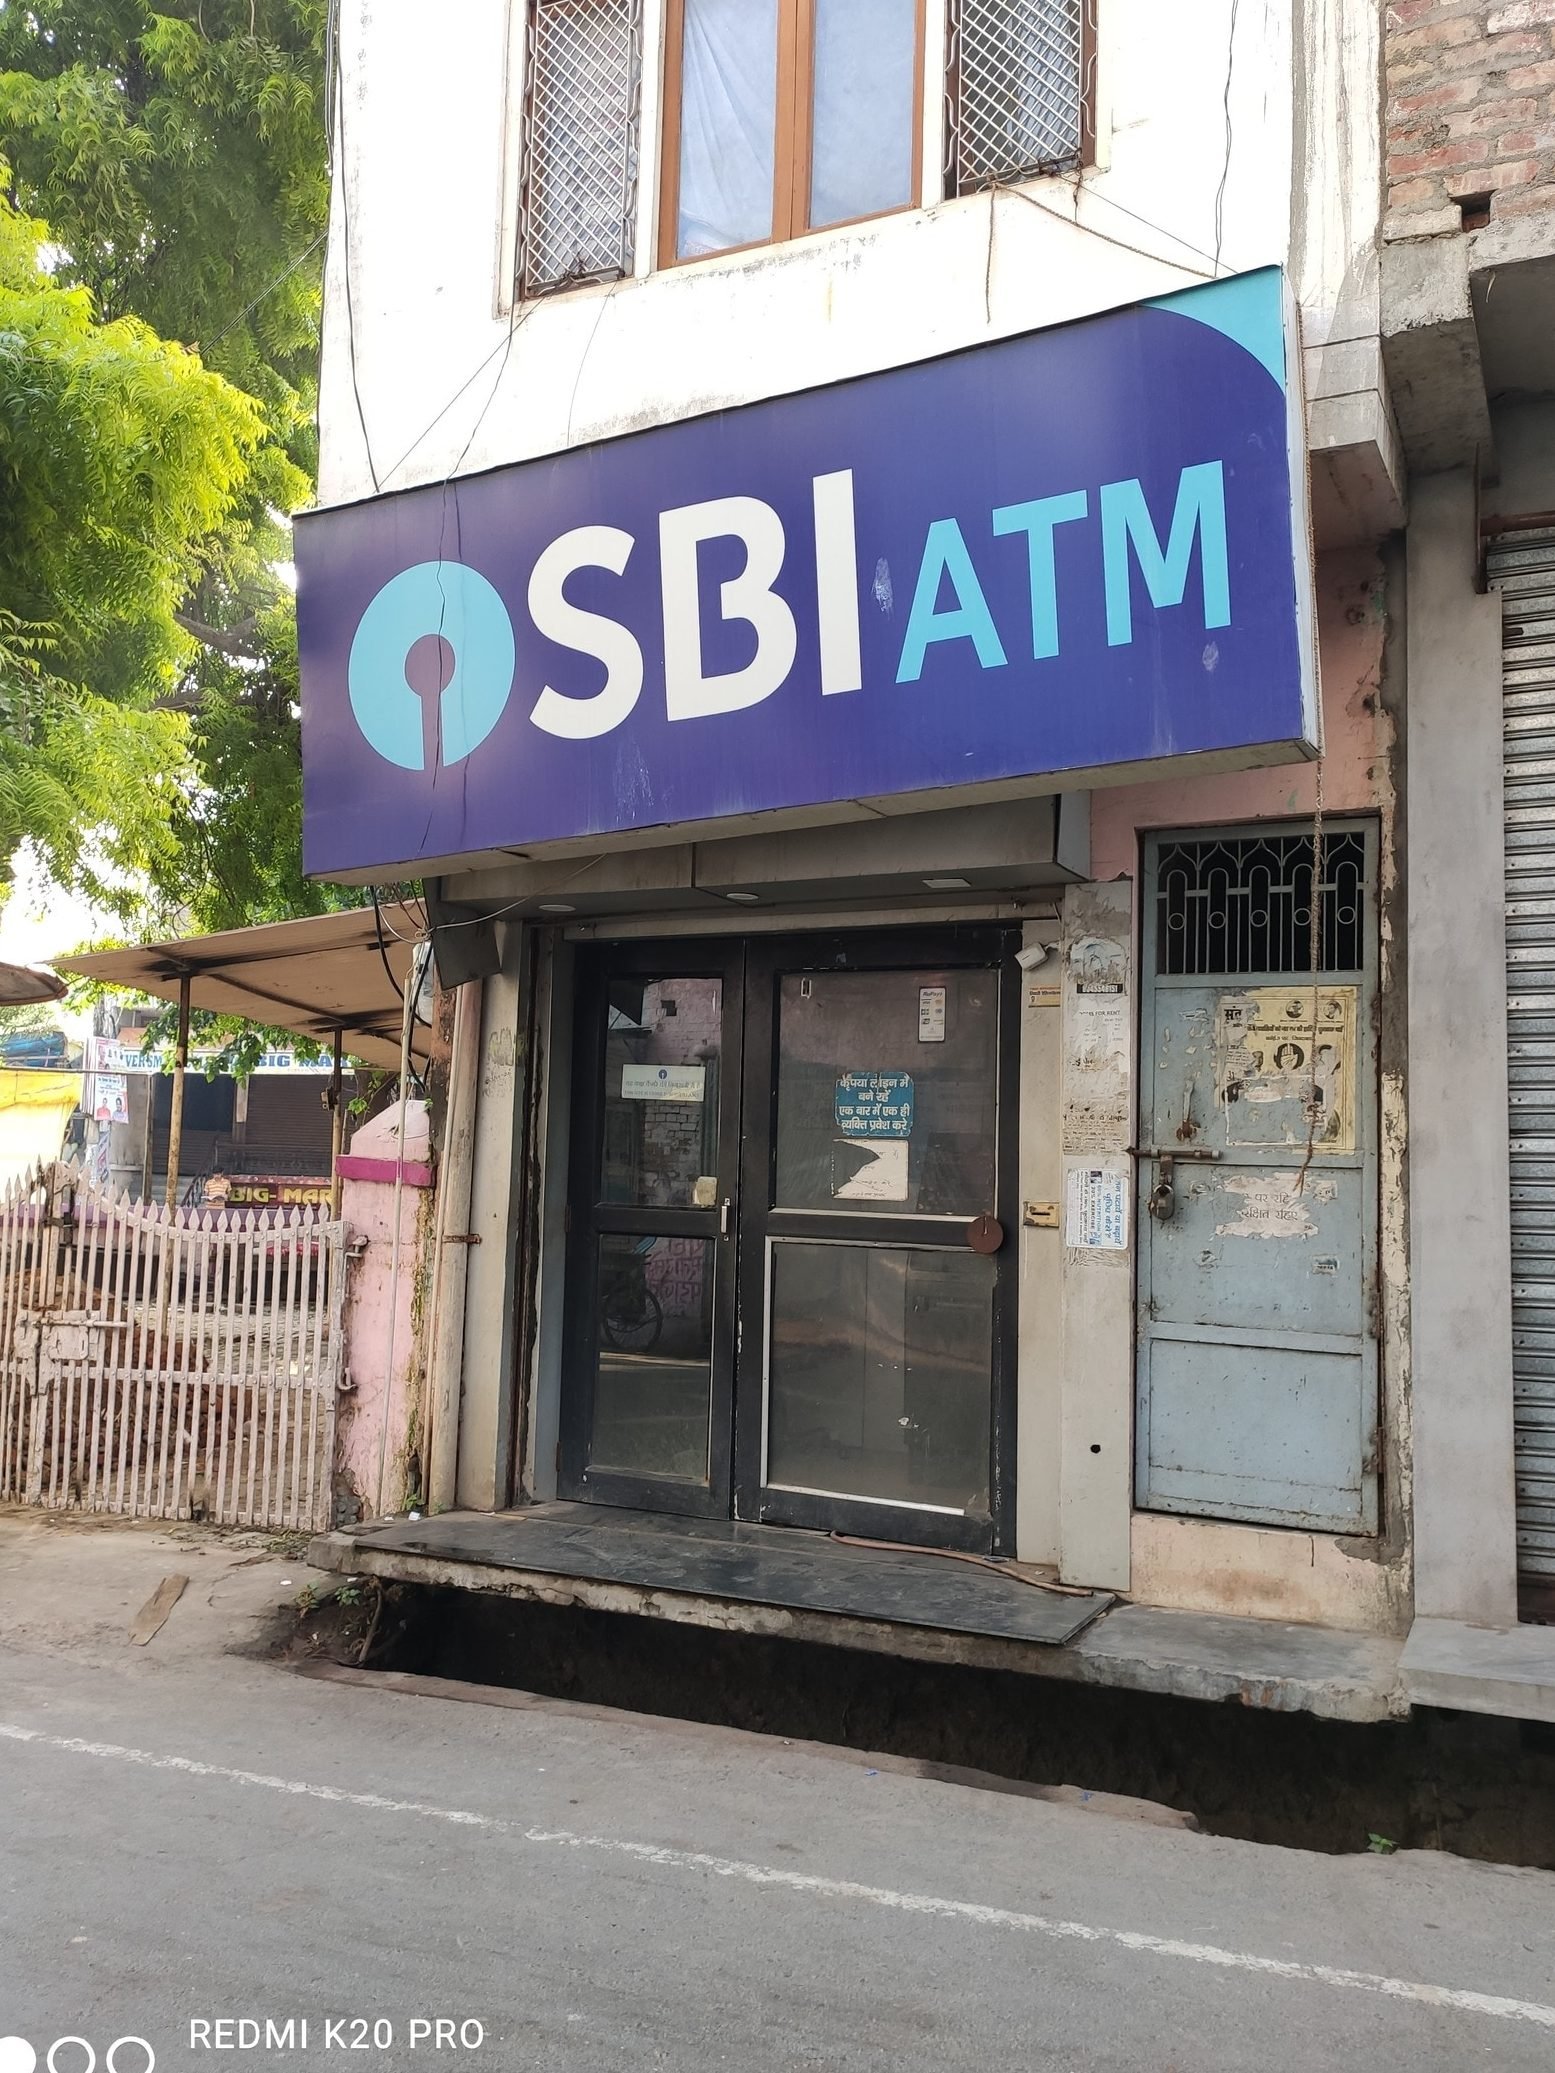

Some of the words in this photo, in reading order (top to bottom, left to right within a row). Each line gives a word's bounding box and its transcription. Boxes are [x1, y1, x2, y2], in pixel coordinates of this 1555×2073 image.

[527, 468, 863, 740] SBI
[895, 459, 1232, 684] ATM
[858, 1088, 874, 1101] बने
[875, 1089, 890, 1103] रहें
[838, 1105, 854, 1116] एक
[855, 1105, 871, 1116] बार
[872, 1102, 882, 1116] में
[883, 1105, 898, 1116] एक
[900, 1102, 910, 1117] ही
[841, 1115, 868, 1131] व्यक्ति
[869, 1117, 890, 1131] प्रवेश
[1273, 1191, 1290, 1204] रहि
